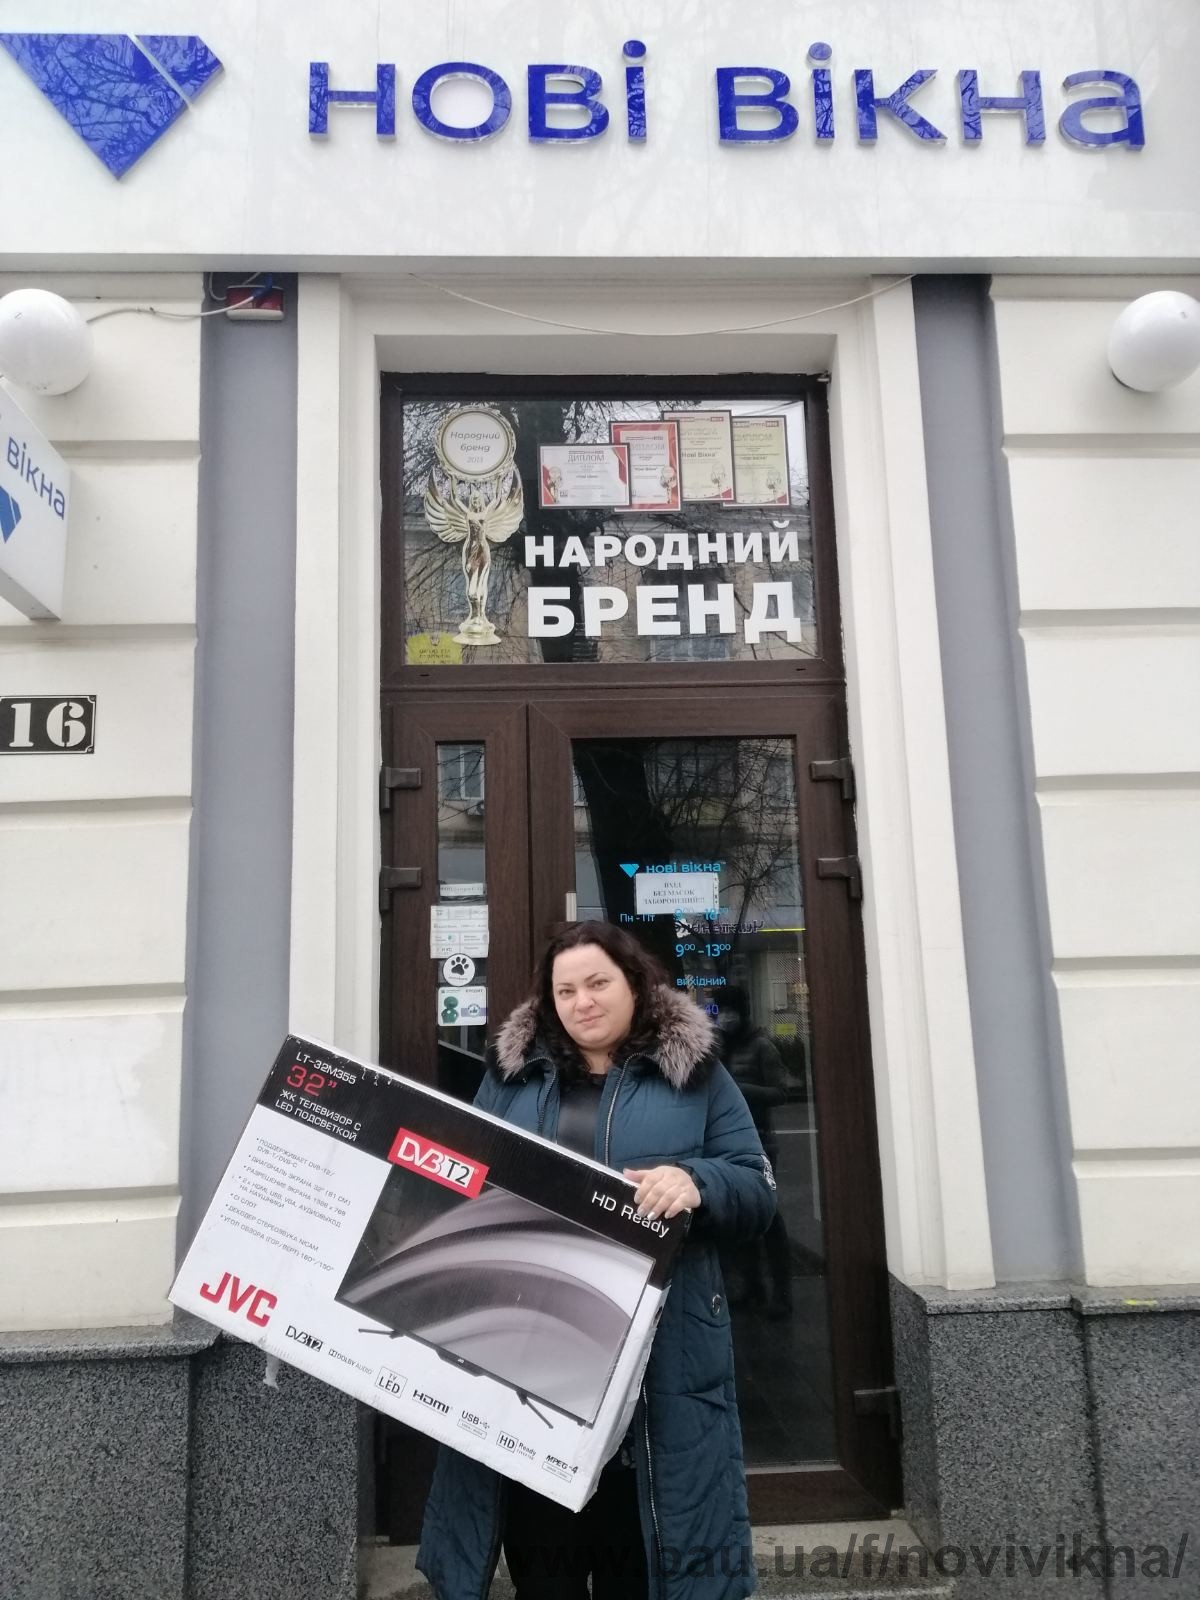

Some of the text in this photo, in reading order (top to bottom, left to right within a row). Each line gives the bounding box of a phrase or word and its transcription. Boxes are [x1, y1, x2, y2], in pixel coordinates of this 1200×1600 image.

[450, 431, 501, 441] Народний
[460, 442, 491, 453] бренд
[567, 454, 605, 463] ДИПЛОМ
[524, 520, 800, 571] НАРОДНИЙ
[527, 581, 801, 645] БРЕНД
[8, 701, 87, 748] 16
[295, 1051, 357, 1085] LT-32M355
[274, 1099, 358, 1142] LED ПОДСВЕТКОЙ
[279, 1089, 297, 1102] ЖК
[297, 1097, 353, 1127] ТЕЛЕВИЗОР
[259, 1138, 307, 1164] ПОДДЕРЖИВАЕТ
[250, 1156, 288, 1176] ДИАГОНАЛЬ
[287, 1172, 312, 1188] ЭКРАНА
[589, 1190, 671, 1237] HD Ready
[199, 1271, 278, 1328] JVC
[377, 1376, 401, 1395] LED
[387, 1373, 397, 1381] TV
[460, 1410, 480, 1425] USB
[497, 1434, 516, 1450] HD
[517, 1442, 537, 1457] Ready
